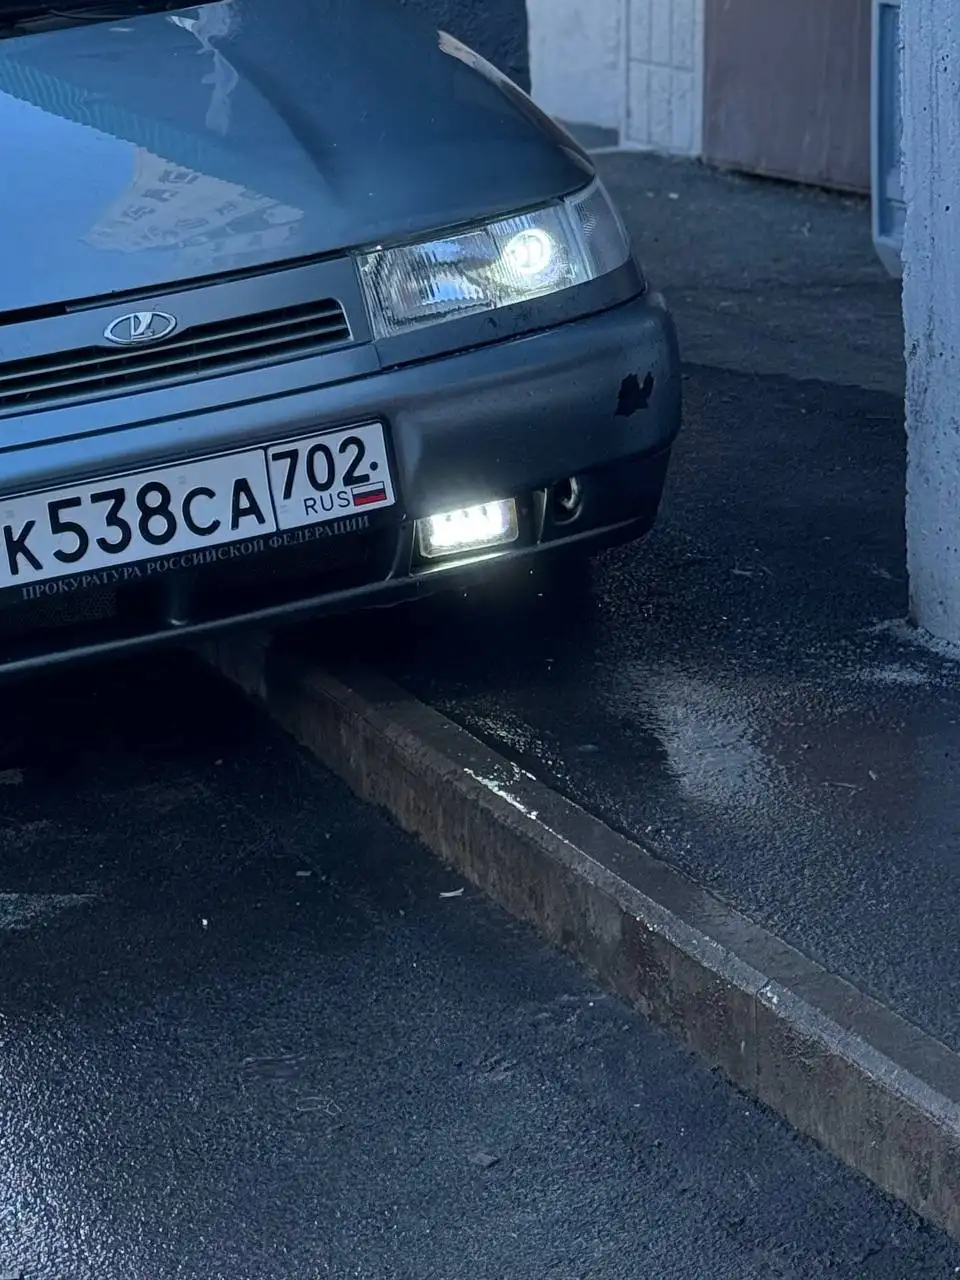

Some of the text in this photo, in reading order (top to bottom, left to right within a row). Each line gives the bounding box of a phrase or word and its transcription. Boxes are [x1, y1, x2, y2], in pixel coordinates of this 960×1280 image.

[271, 435, 371, 500] 702
[303, 490, 351, 517] RUS
[21, 515, 371, 600] ПРОКУРАТУРА РОССИЙСКОЙ ФЕДЕРАЦИИ
